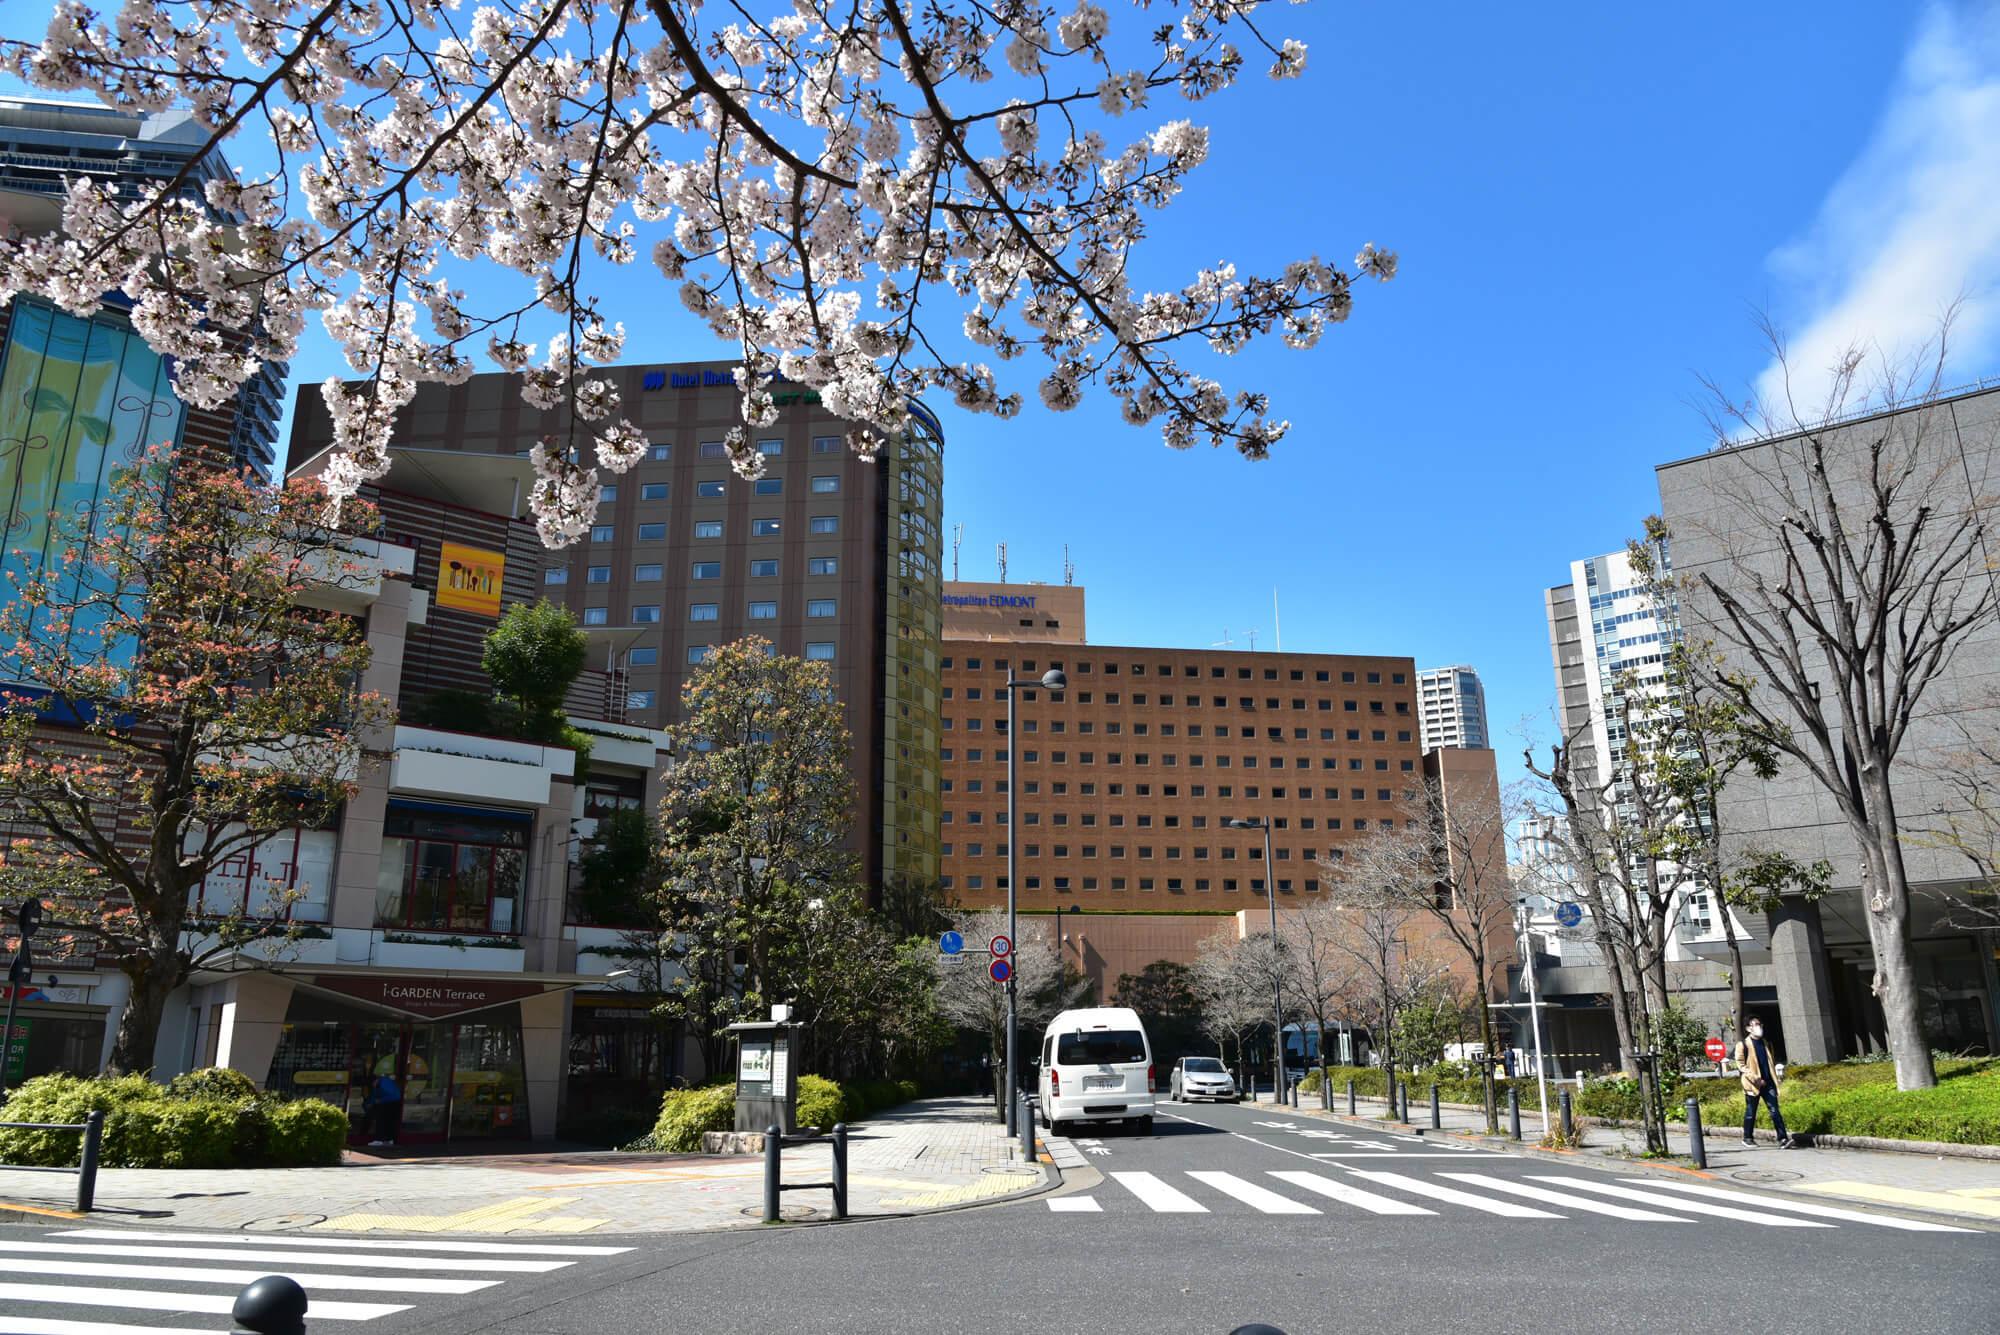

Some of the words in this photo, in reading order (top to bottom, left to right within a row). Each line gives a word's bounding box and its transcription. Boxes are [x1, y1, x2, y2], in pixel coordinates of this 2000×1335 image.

[671, 371, 700, 388] Hotel
[943, 594, 987, 607] etropolitan
[989, 594, 1037, 608] EDMONT
[994, 940, 1007, 953] 30
[383, 983, 441, 999] i-GARDEN
[445, 988, 486, 1000] Terrace
